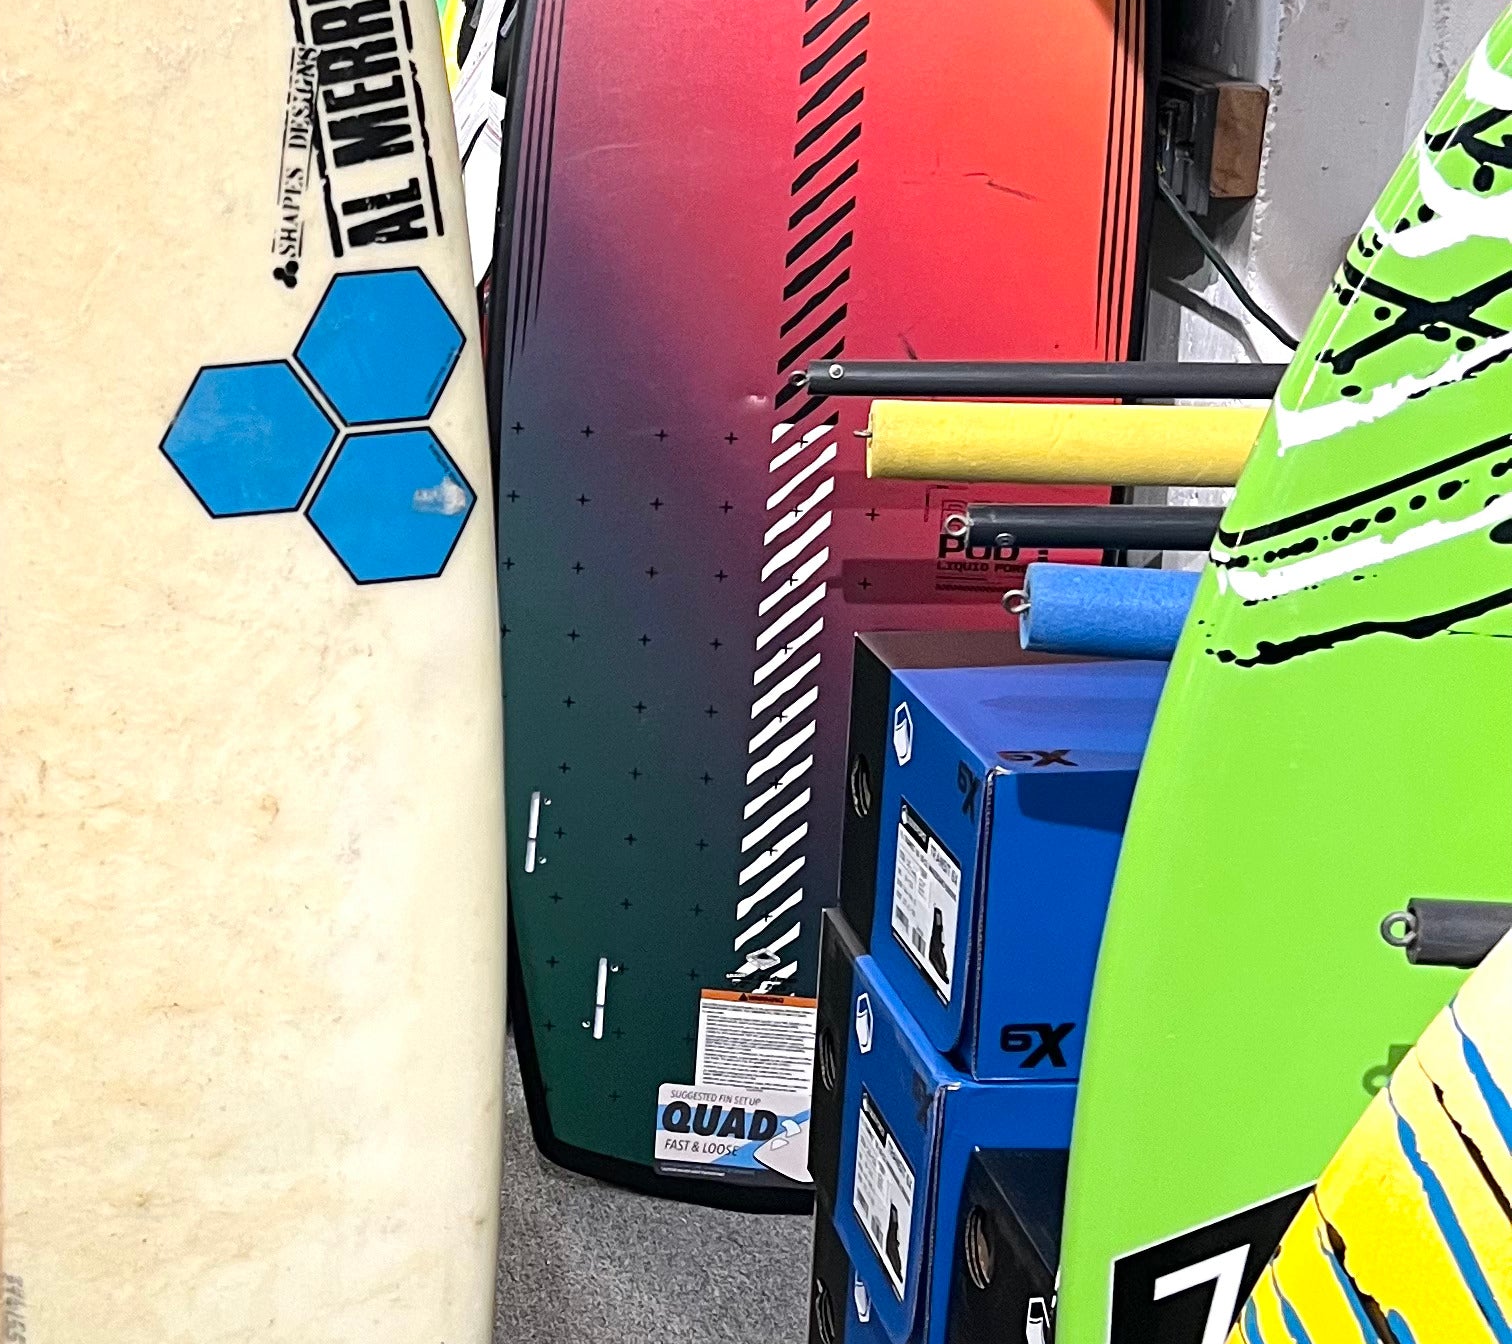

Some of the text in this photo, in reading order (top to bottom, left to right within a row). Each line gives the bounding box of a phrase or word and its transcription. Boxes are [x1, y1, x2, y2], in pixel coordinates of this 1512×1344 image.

[278, 166, 304, 258] SHAPES
[341, 177, 429, 248] AL
[1000, 1022, 1076, 1068] 6X
[671, 1089, 718, 1103] SUGGESTED
[719, 1094, 733, 1104] FIN
[662, 1101, 778, 1142] QUAD
[665, 1138, 738, 1157] FAST & LOOSE
